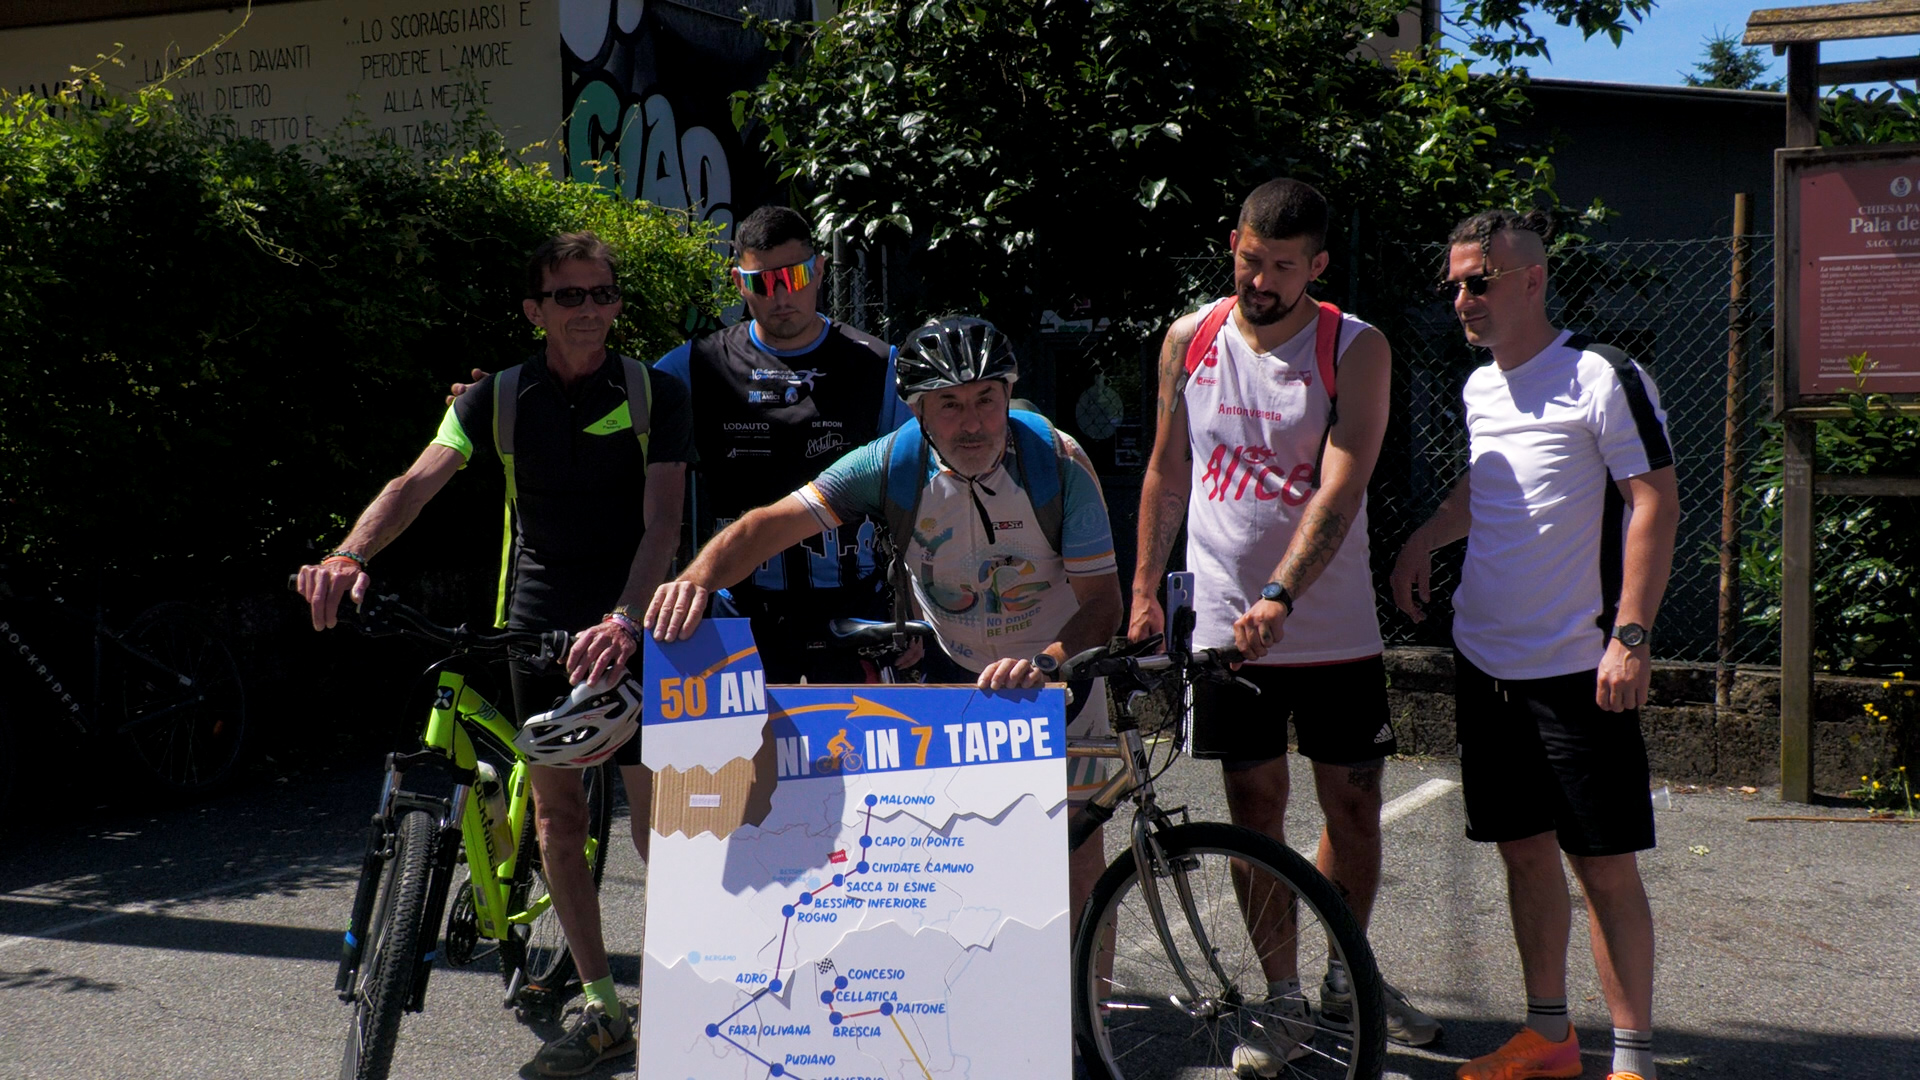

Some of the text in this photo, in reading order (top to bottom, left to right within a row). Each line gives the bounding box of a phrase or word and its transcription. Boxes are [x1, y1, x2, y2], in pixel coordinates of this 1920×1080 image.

[391, 4, 506, 40] SCORAGGIARSI
[520, 1, 531, 26] E
[215, 52, 242, 76] STA
[250, 44, 311, 72] DAVANTI
[361, 49, 431, 80] PERDERE
[216, 83, 271, 111] DIETRO
[384, 88, 424, 113] ALLA
[251, 116, 299, 141] PETTO
[306, 115, 316, 138] E
[1858, 204, 1902, 215] CHIESA
[1849, 216, 1891, 234] Pala
[1865, 239, 1898, 248] SACCA
[723, 422, 770, 430] LODAUTO
[987, 617, 1002, 627] NO
[987, 619, 1032, 637] BE FREE
[0, 621, 80, 712] ROCKRIDER
[660, 669, 766, 719] 50 AN
[776, 717, 1052, 777] NI IN 7 TAPPE
[879, 794, 935, 806] MALONNO
[875, 836, 965, 848] CAPO DI PONTE
[872, 862, 974, 874] CIVIDATE CAMUNO
[846, 881, 936, 893] SACCA DI ESINE
[814, 897, 927, 909] BESSIMO INFERIORE
[797, 911, 838, 923] ROGNO
[736, 972, 767, 984] ADRO
[848, 968, 905, 981] CONCESIO
[835, 991, 898, 1003] CELLATICA
[895, 1003, 946, 1015] PAITONE
[728, 1025, 811, 1036] FARA OLIVANA
[832, 1026, 882, 1038] BRESCIA
[785, 1054, 836, 1066] PUDIANO
